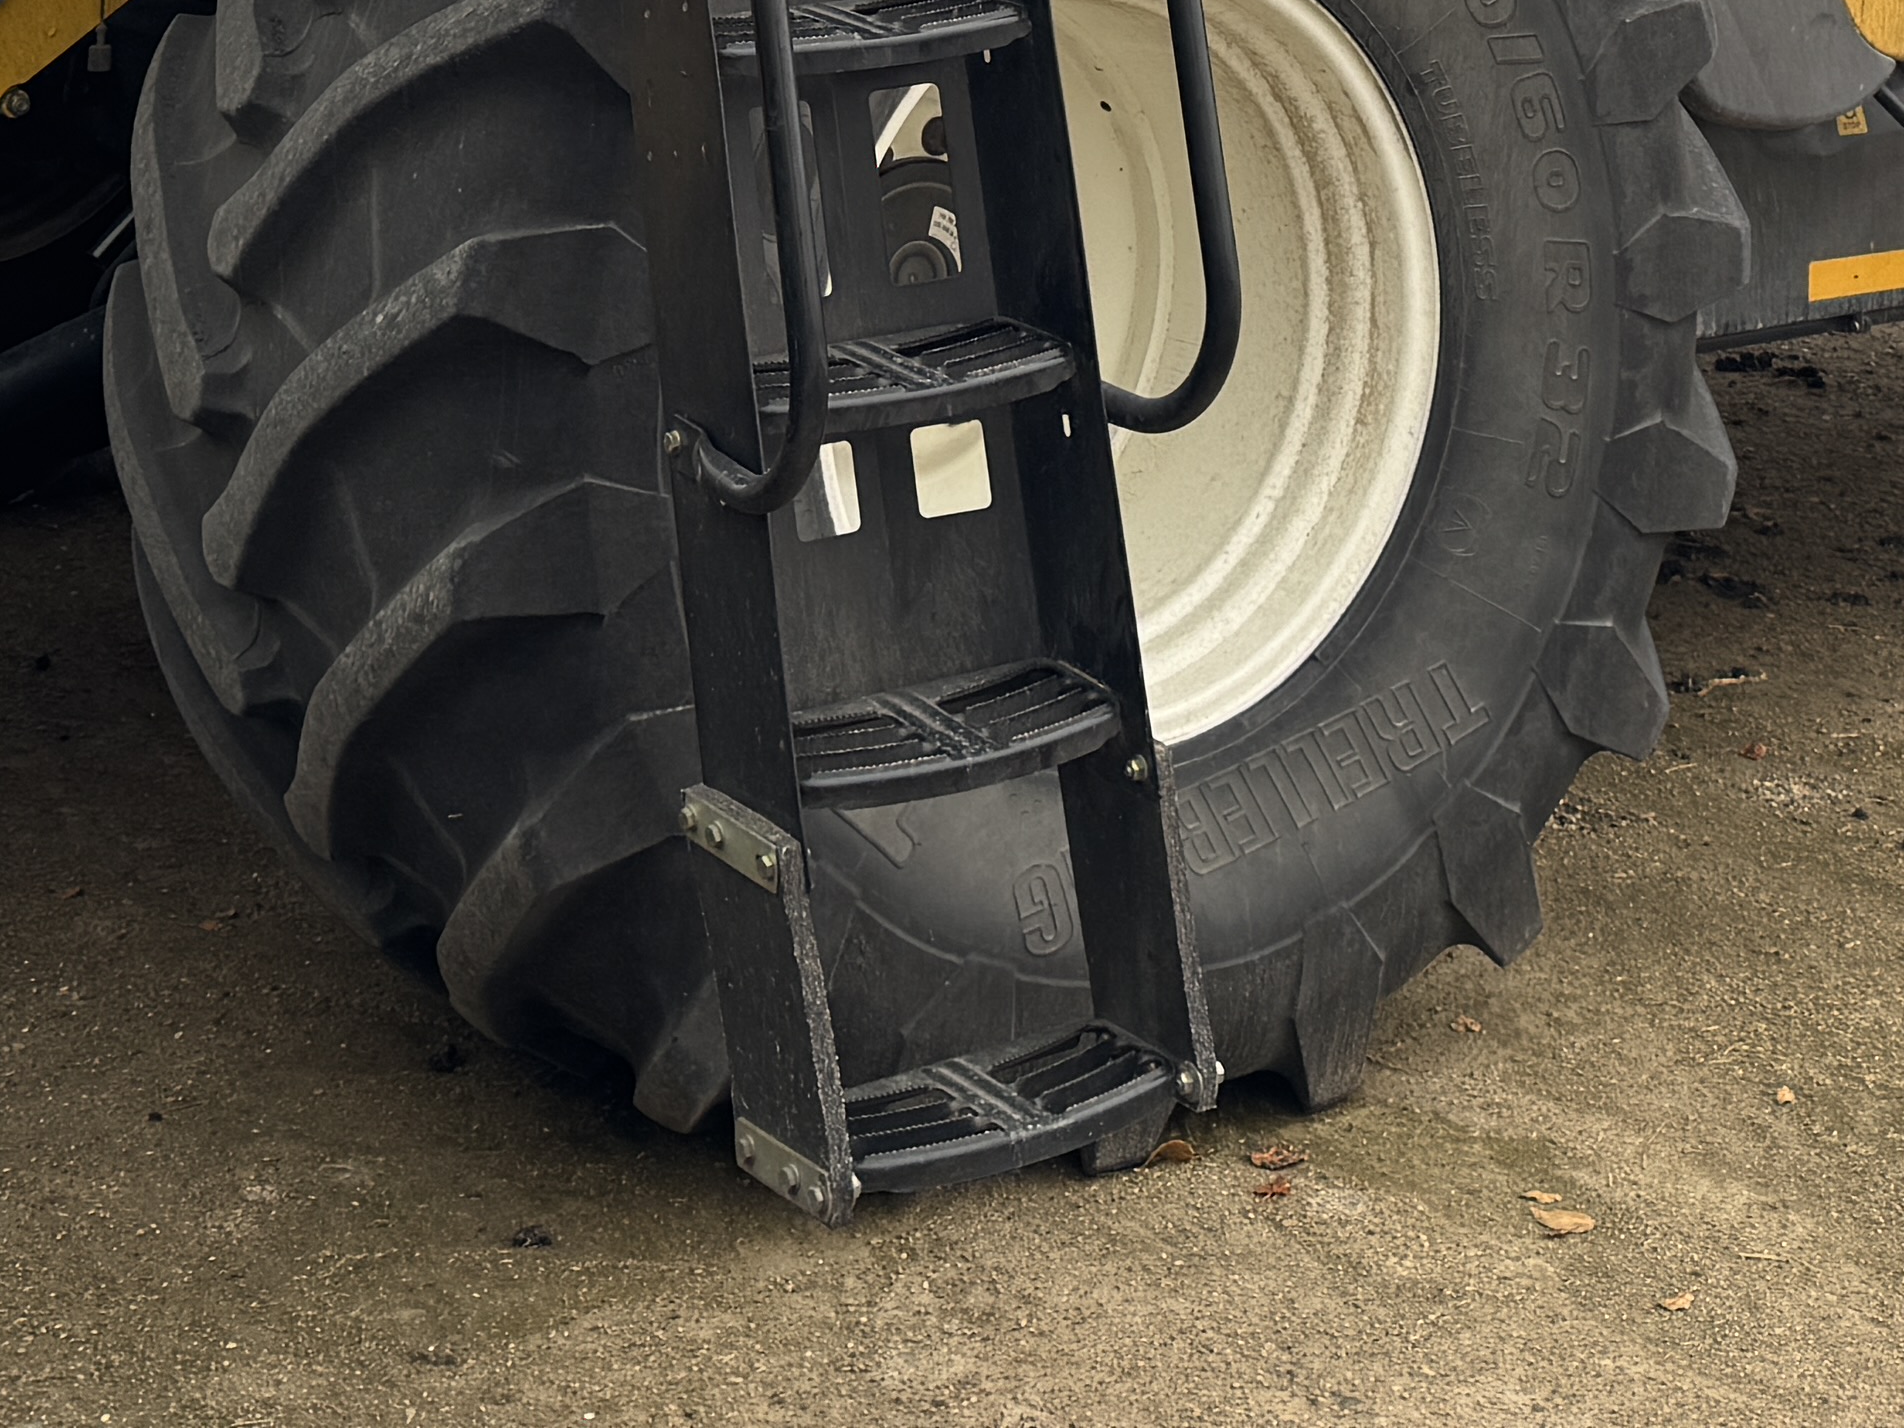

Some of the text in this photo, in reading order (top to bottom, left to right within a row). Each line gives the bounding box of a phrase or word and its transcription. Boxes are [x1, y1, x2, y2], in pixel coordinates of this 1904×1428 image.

[1420, 59, 1498, 302] TUBELESS
[1543, 240, 1591, 313] R
[1525, 339, 1591, 498] 32
[1011, 660, 1493, 956] TRELLEBG
